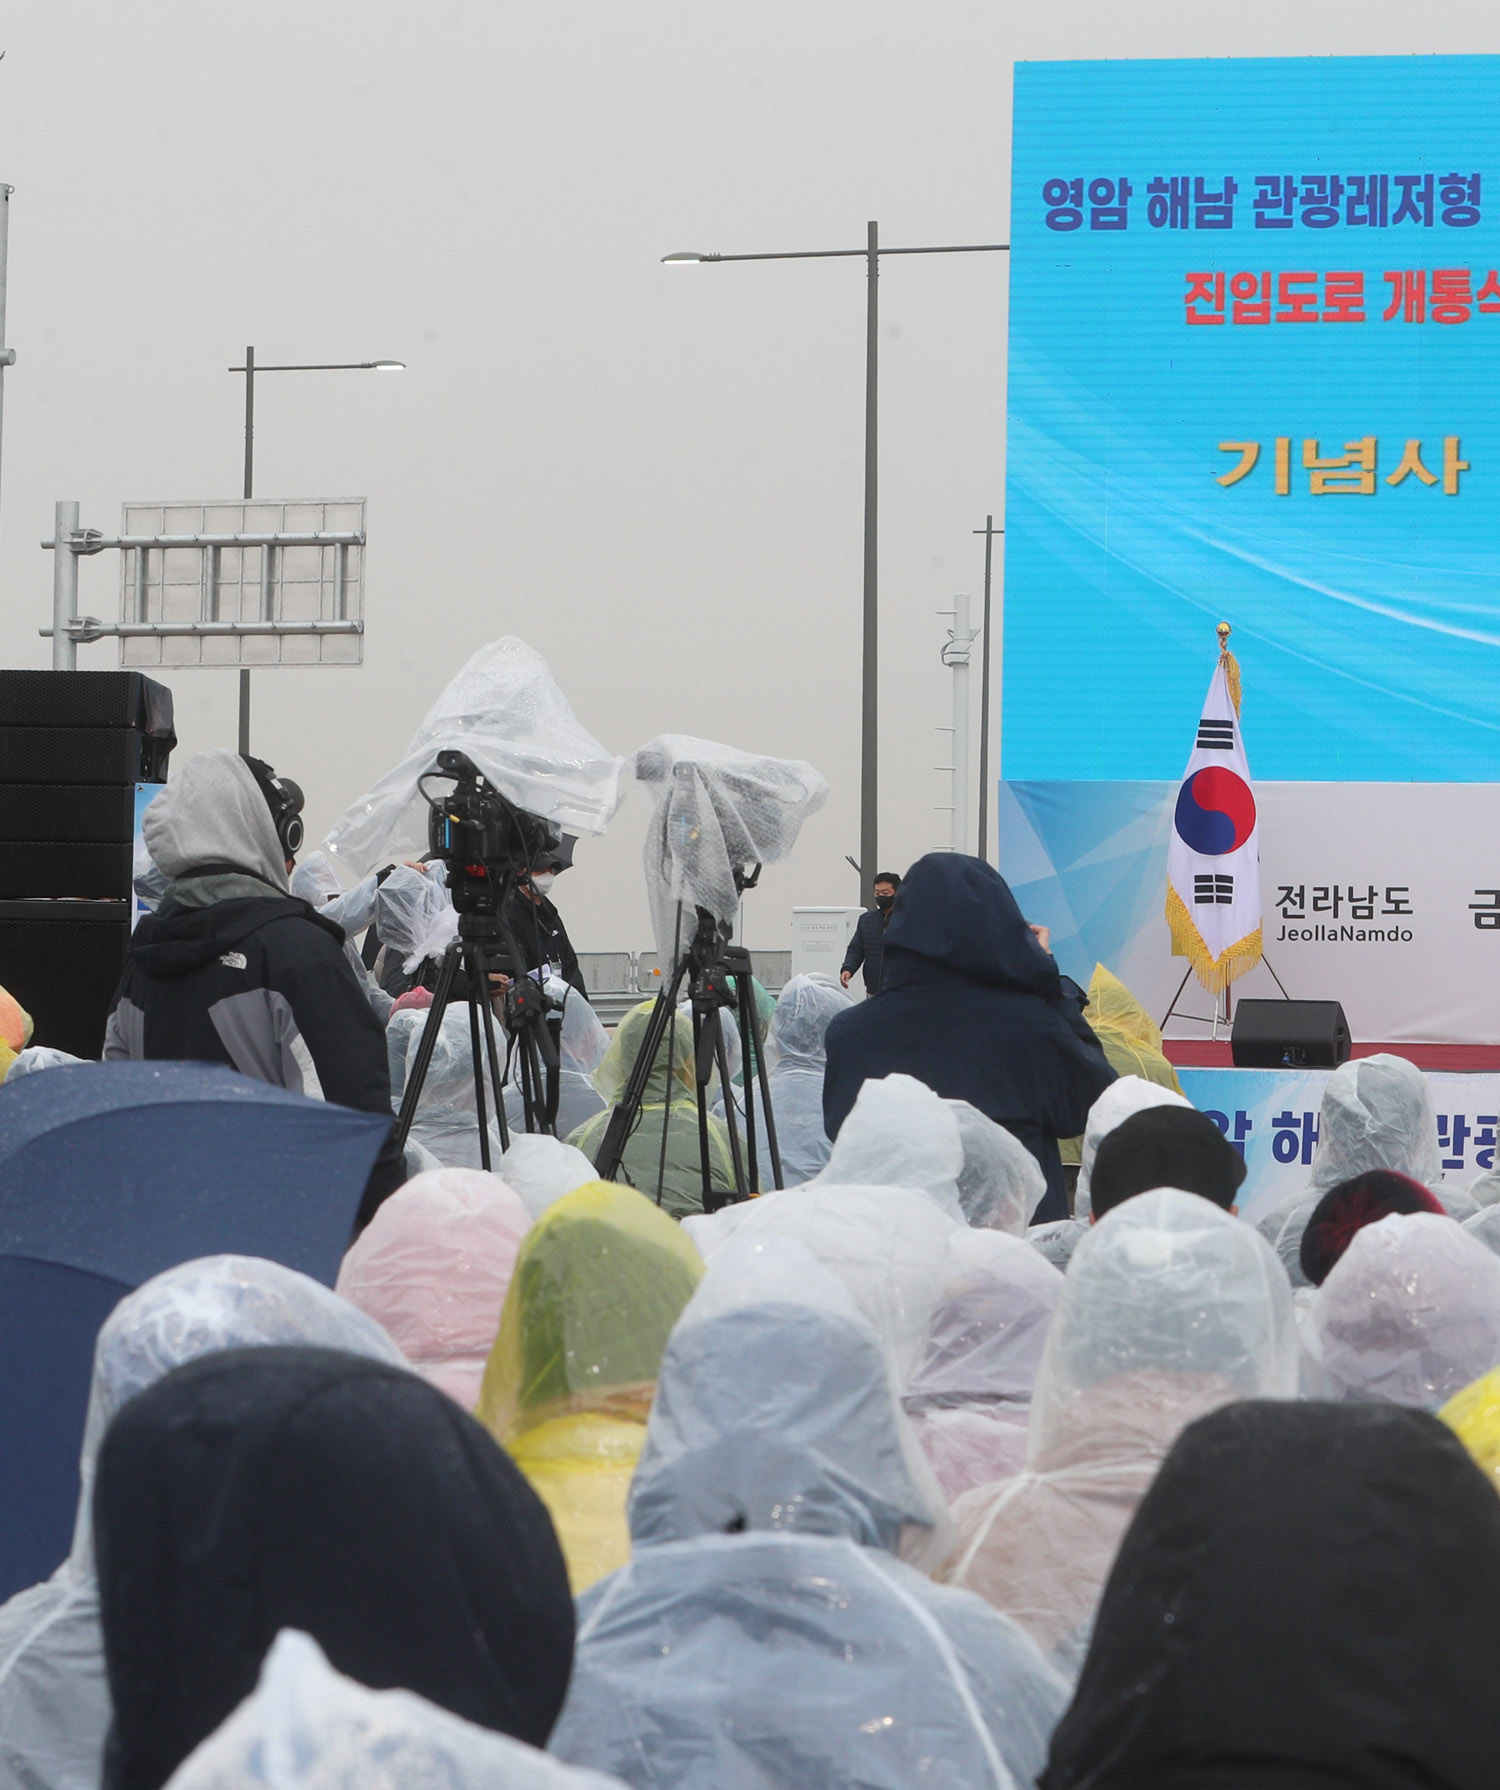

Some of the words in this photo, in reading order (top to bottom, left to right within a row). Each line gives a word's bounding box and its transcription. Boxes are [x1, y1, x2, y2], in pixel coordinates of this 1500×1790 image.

[1042, 177, 1134, 232] 영암
[1146, 176, 1238, 230] 해남
[1252, 173, 1482, 230] 관광레저형
[1184, 271, 1366, 326] 진입도로
[1215, 436, 1470, 496] 기념사
[1275, 885, 1414, 920] 전라남도
[1276, 925, 1414, 942] JeollaNamdo
